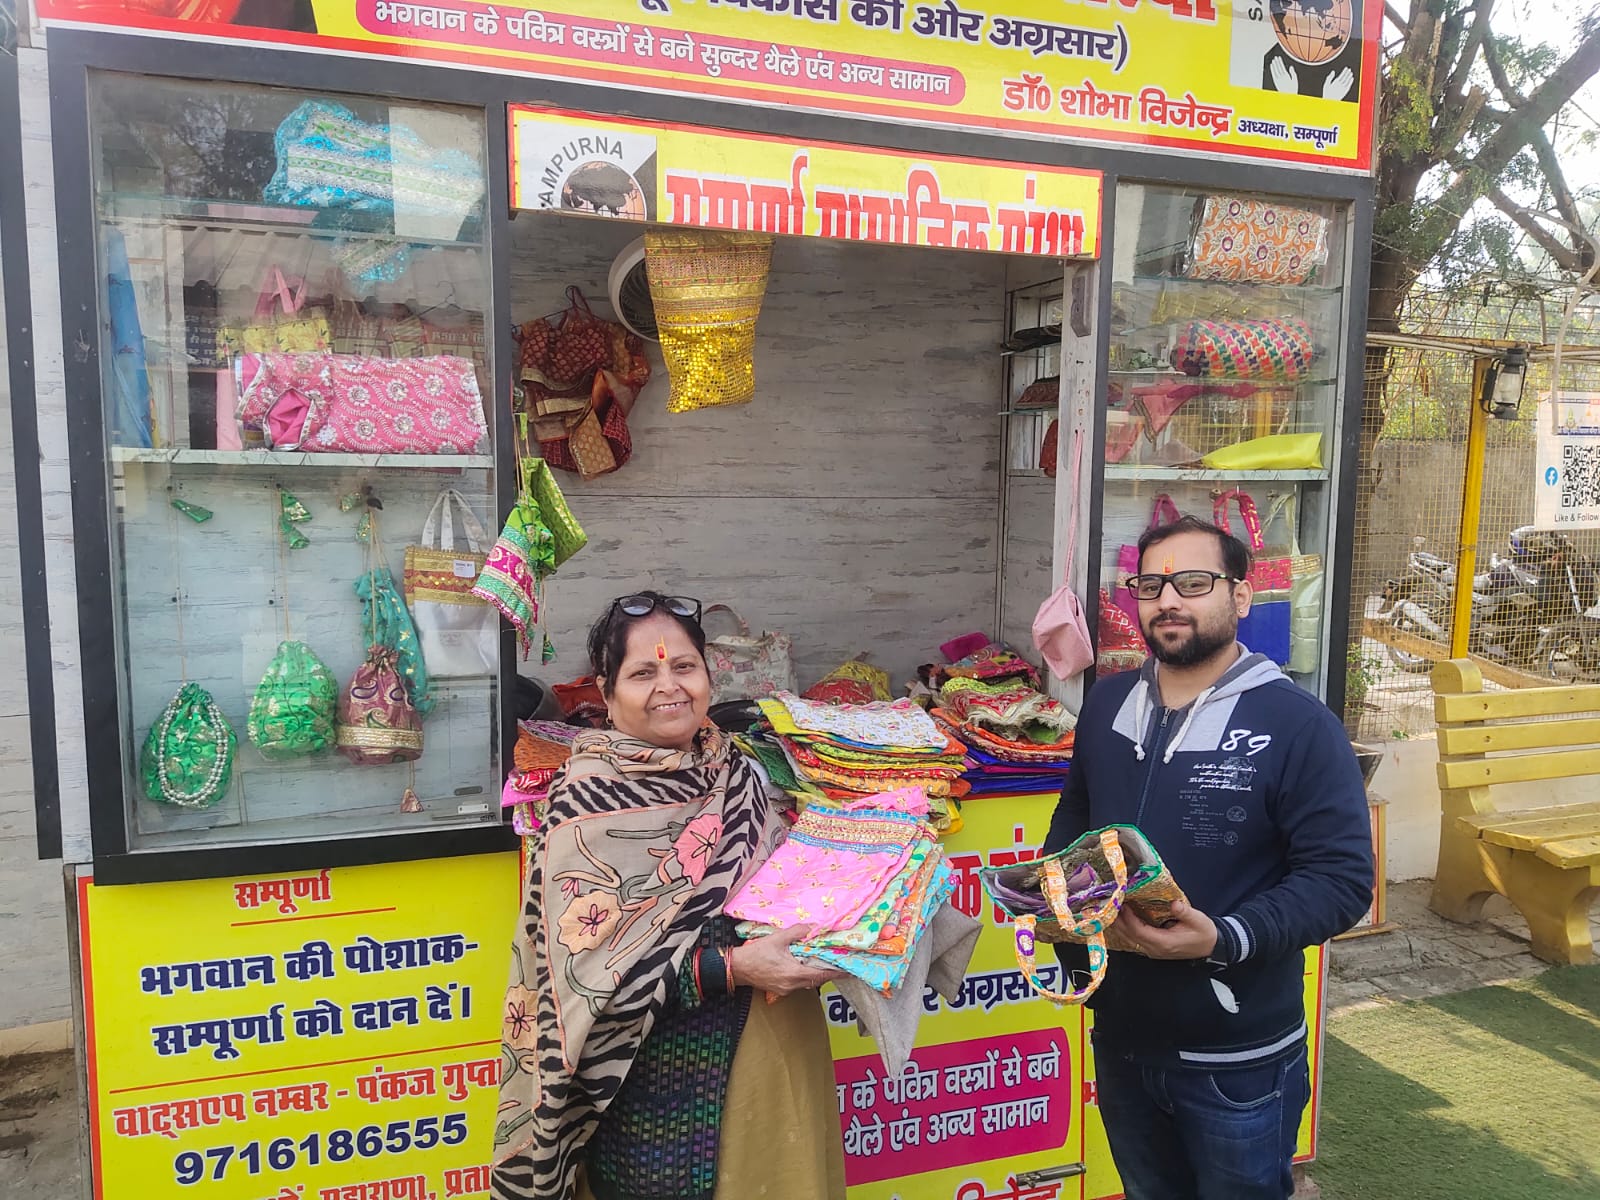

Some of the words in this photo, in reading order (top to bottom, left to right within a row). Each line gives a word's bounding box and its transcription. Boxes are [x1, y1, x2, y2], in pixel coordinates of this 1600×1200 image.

[375, 1, 467, 32] भगवान
[473, 6, 499, 35] के
[506, 10, 565, 45] पवित्र
[572, 23, 631, 53] वस्त्रों
[633, 28, 654, 56] से
[660, 33, 695, 62] बने
[700, 43, 760, 77] सुन्दर
[764, 44, 801, 76] थैले
[805, 52, 834, 80] एंव
[838, 62, 884, 86] अन्य
[889, 68, 951, 95] सामान
[913, 6, 983, 40] ओर
[989, 19, 1128, 70] अग्रसार)
[1060, 80, 1132, 121] शोभा
[1140, 84, 1232, 136] विजेन्द्र
[1238, 119, 1289, 139] अध्यक्षा,
[1293, 125, 1338, 149] सम्पूर्णा
[537, 136, 624, 208] AMPURNA
[1554, 513, 1569, 522] Like
[1570, 513, 1576, 521] &
[1577, 512, 1600, 521] Follow
[234, 869, 331, 914] सम्पूर्णा
[140, 955, 276, 996] भगवान
[284, 943, 334, 979] की
[344, 934, 478, 974] पोशाक-
[152, 1004, 285, 1060] सम्पूर्णा
[293, 1000, 342, 1038] को
[352, 994, 417, 1030] दान
[113, 1094, 246, 1140] वाट्सएप
[253, 1082, 328, 1118] नम्बर
[357, 1066, 435, 1103] पंकज
[442, 1059, 502, 1101] गुप्ता
[852, 1069, 877, 1110] के
[883, 1061, 939, 1105] पवित्र
[944, 1049, 1000, 1095] वस्त्रों
[1002, 1047, 1023, 1087] से
[1027, 1041, 1061, 1081] बने
[174, 1113, 468, 1185] 9716186555
[844, 1114, 884, 1156] थैले
[889, 1108, 922, 1151] एंव
[926, 1108, 976, 1142] अन्य
[981, 1095, 1050, 1134] सामान
